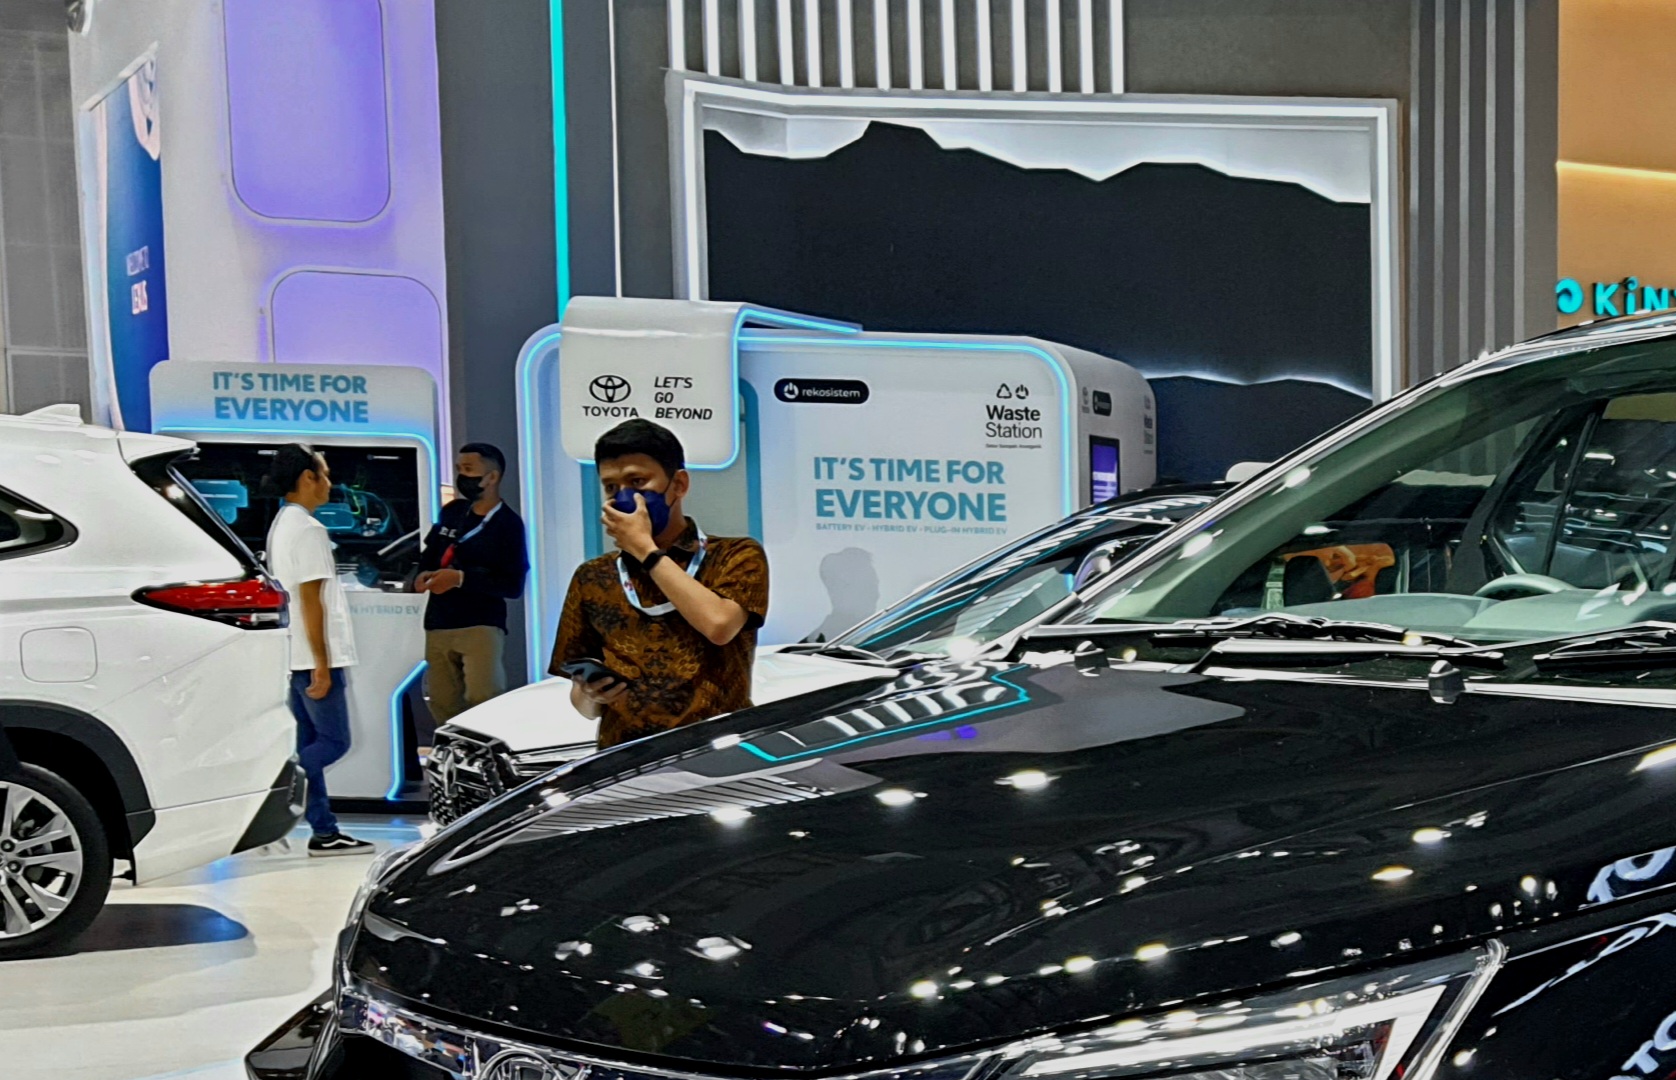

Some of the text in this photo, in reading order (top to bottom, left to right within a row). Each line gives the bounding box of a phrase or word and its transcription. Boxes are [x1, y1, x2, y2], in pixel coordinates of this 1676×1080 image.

[213, 371, 367, 394] IT'S TIME FOR
[654, 376, 693, 389] LET'S
[654, 392, 674, 404] GO
[802, 387, 861, 398] rekosistem
[214, 396, 369, 423] EVERYONE
[582, 406, 639, 418] TOYOTA
[655, 407, 713, 420] BEYOND
[985, 404, 1041, 421] Waste
[985, 421, 1042, 439] Station
[814, 457, 1005, 484] IT'S TIME FOR
[815, 489, 1007, 522] EVERYONE
[816, 523, 852, 531] BATTERY
[872, 525, 904, 533] HYBRID
[962, 527, 994, 535] HYBRID
